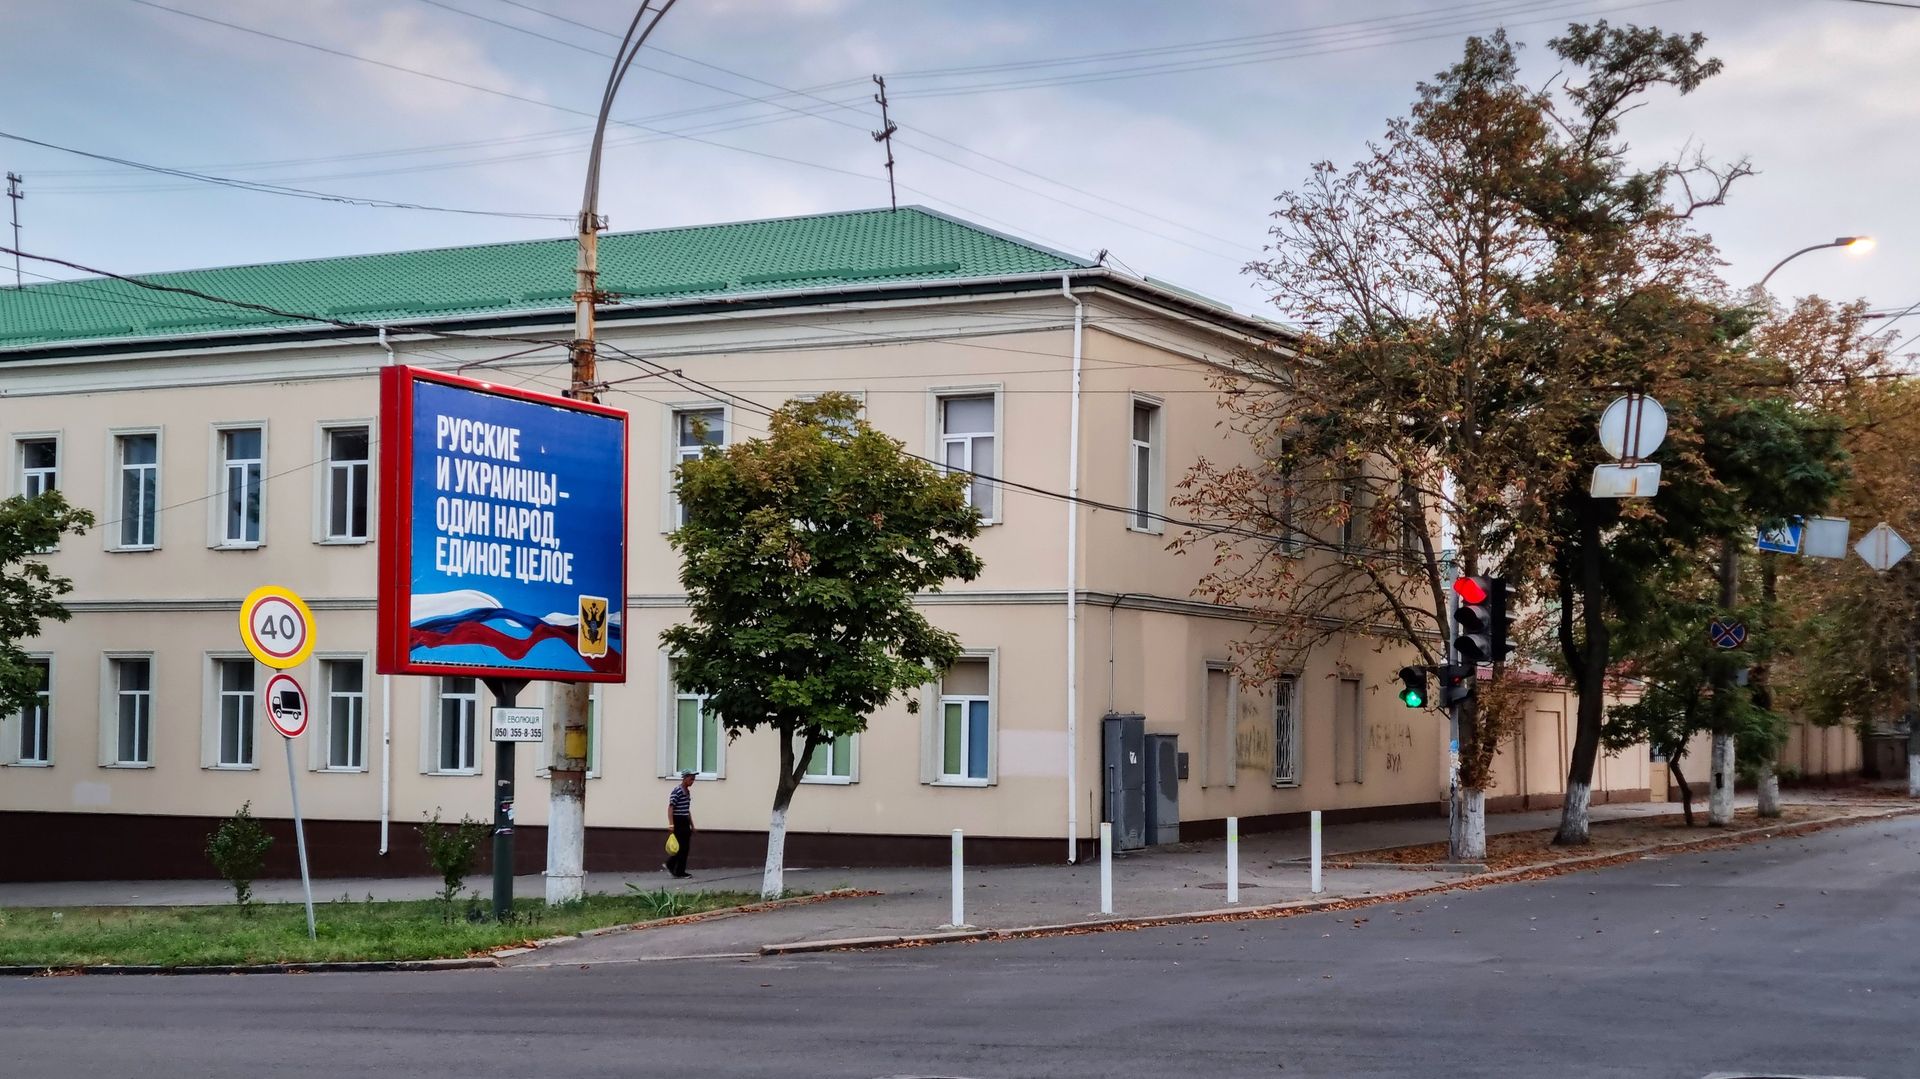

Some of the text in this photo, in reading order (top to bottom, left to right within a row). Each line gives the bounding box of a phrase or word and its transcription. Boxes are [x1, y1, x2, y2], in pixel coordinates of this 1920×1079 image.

[437, 414, 520, 462] РУССКИЕ
[437, 456, 449, 491] И
[436, 497, 561, 549] ОДИН НАРОД,
[436, 537, 574, 585] ЕДИНОЕ ЦЕЛОЕ
[261, 614, 295, 640] 40
